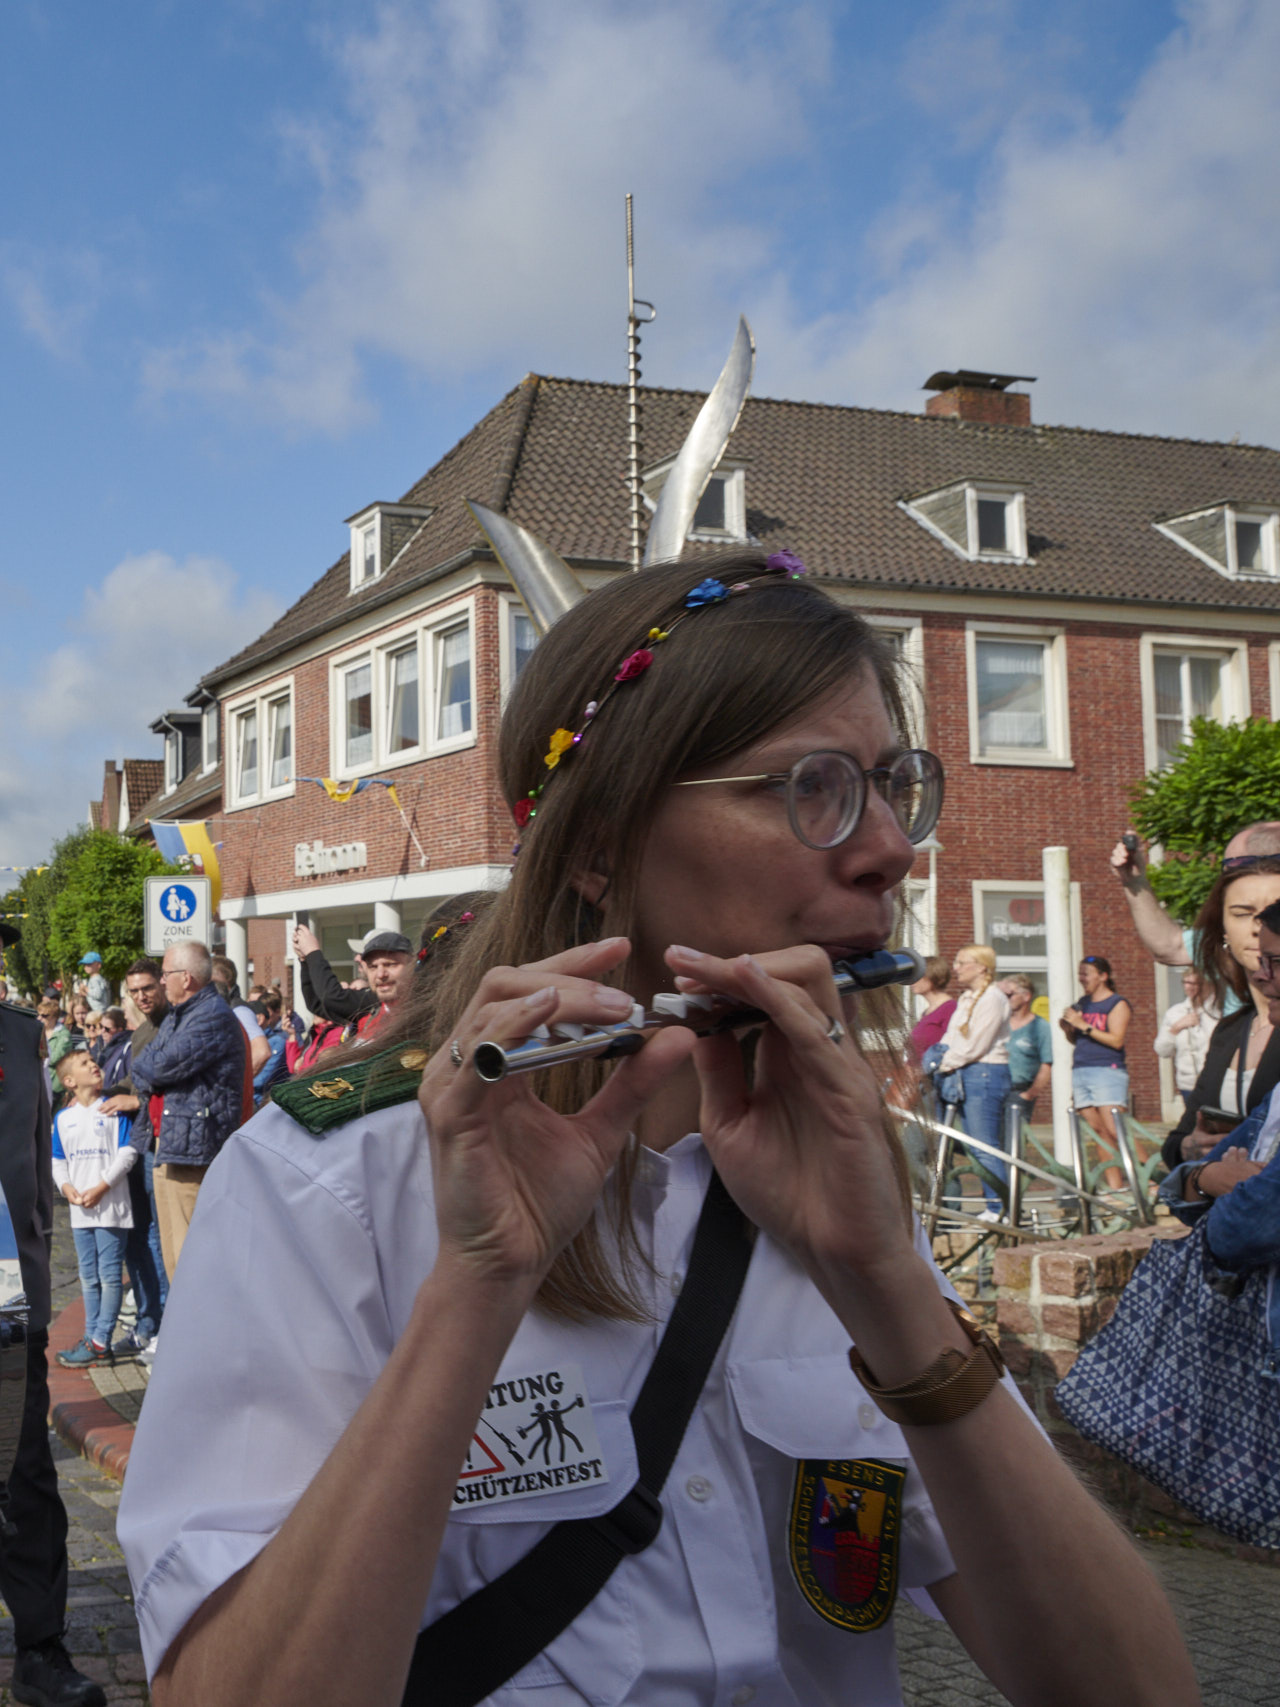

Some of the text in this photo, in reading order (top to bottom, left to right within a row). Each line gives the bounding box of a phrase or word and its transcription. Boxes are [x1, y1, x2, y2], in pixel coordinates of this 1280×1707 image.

[163, 925, 193, 936] ZONE
[485, 1371, 564, 1409] TUNG
[452, 1458, 603, 1505] CHÜTZENFEST
[827, 1460, 886, 1486] ESENS
[878, 1552, 892, 1592] VON
